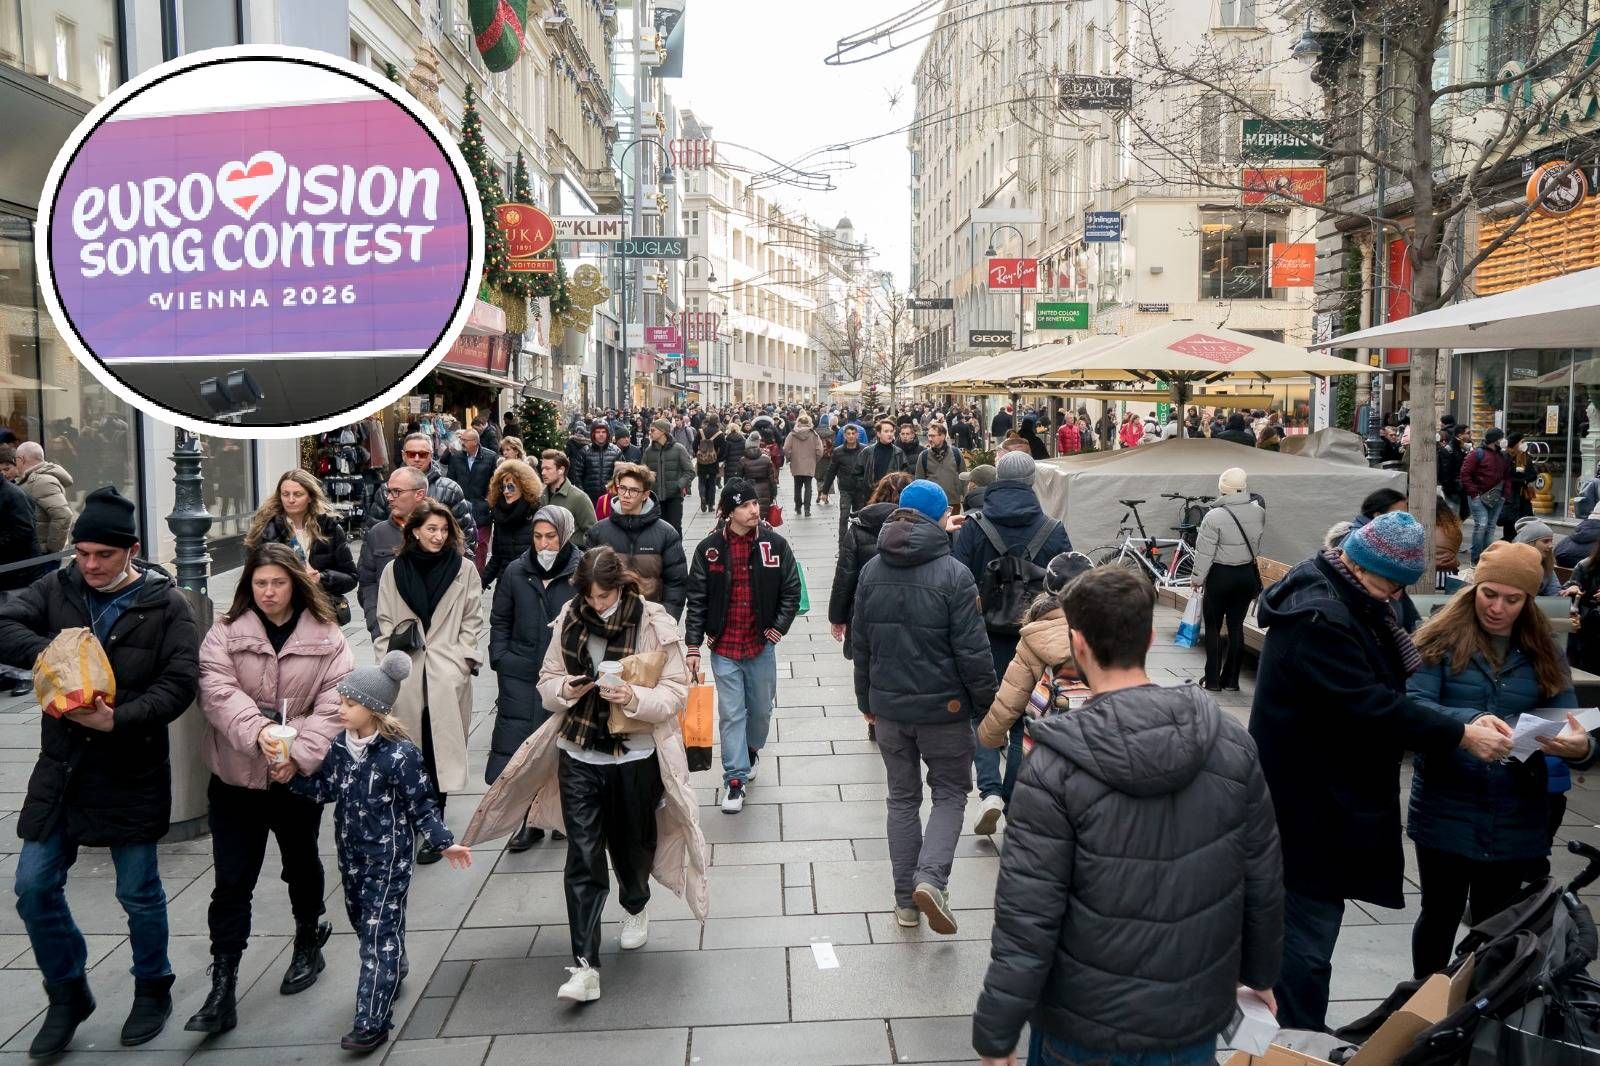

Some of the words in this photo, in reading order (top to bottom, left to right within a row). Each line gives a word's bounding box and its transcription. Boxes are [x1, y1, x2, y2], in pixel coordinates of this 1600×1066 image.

[505, 228, 544, 242] UKA
[574, 221, 628, 235] KLIMT
[990, 261, 1035, 284] Ray-Ban
[971, 335, 1011, 343] GEOX
[759, 541, 780, 568] L
